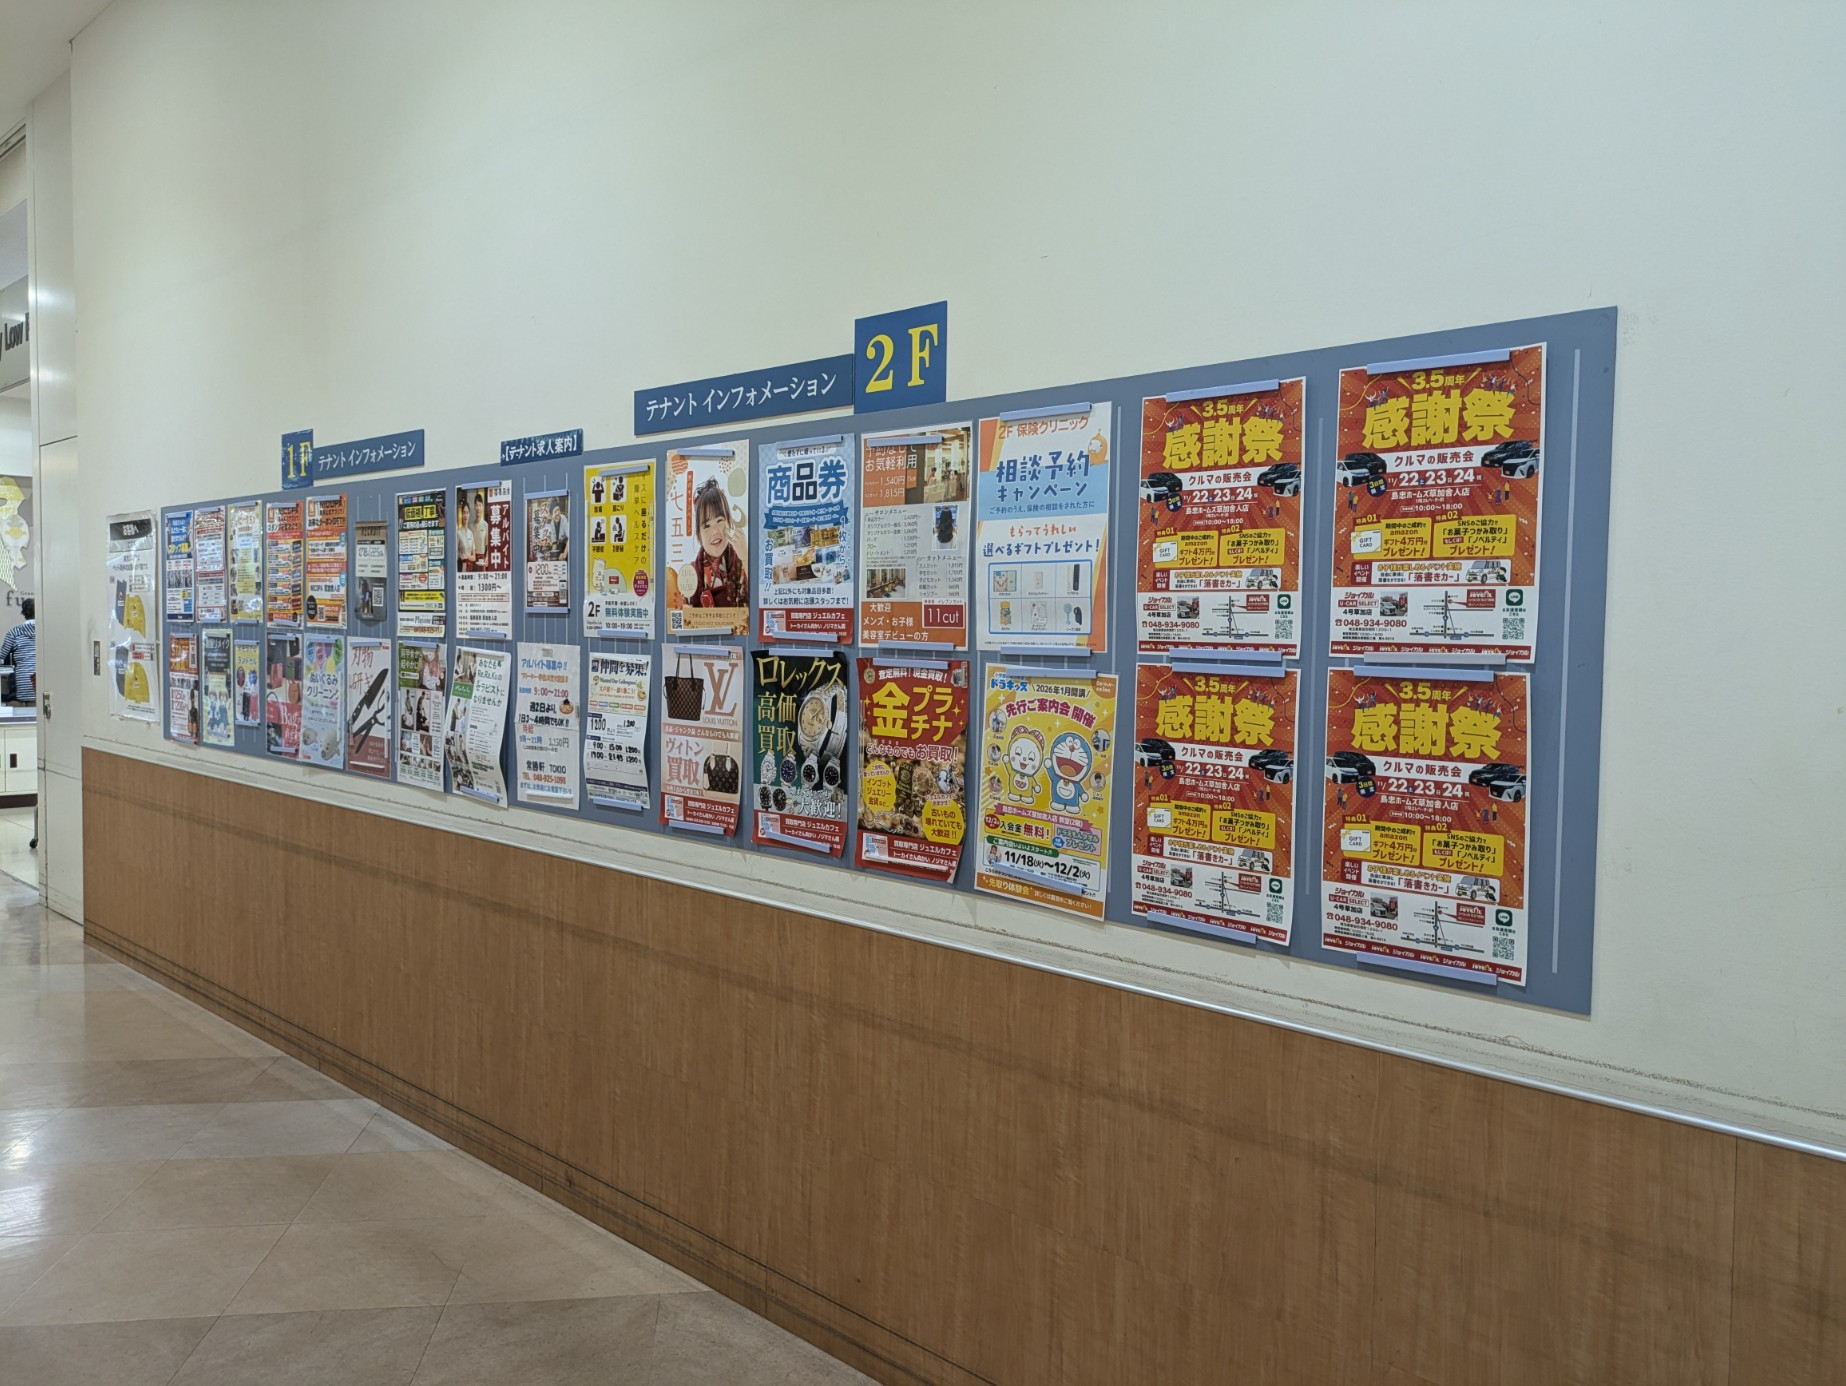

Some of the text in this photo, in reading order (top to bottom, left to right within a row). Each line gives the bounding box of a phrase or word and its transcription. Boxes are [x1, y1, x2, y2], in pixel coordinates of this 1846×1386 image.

[5, 322, 23, 351] Low
[866, 324, 938, 393] 2F
[1412, 369, 1465, 390] 3.5周年
[646, 373, 837, 421] テナントインフォメーション
[1202, 400, 1244, 417] 3.5周年
[1362, 388, 1515, 449] 感謝祭
[999, 416, 1089, 440] 2F 保険クリニック
[1162, 416, 1284, 469] 感謝祭
[288, 442, 313, 478] 1F
[318, 442, 416, 471] テナントインフォメーション
[866, 454, 917, 472] お気軽利用
[1394, 450, 1475, 468] クルマの販売会
[996, 450, 1090, 483] 相談予約
[767, 460, 846, 504] 商品券
[880, 475, 905, 486] 1,540円
[1188, 471, 1252, 486] クルマの販売会
[880, 487, 905, 499] 1,815円
[997, 482, 1088, 502] キャンペーン
[1391, 488, 1470, 500] 島忠ホームズ草加舎人店
[989, 501, 1095, 514] ご予約のうえ、保険の相談をされた方に
[1415, 503, 1463, 511] 10:00〜18:00
[671, 491, 684, 562] 七五三
[1010, 523, 1077, 537] もらってうれしい
[1457, 519, 1499, 527] SNSのご協力で
[490, 504, 501, 569] 募集中
[1443, 527, 1508, 535] 「お菓子つかみ取り」
[1468, 536, 1507, 544] 「ノベルティ」
[983, 539, 1100, 557] 選べるギフトプレゼント!
[1383, 545, 1425, 556] プレゼント!
[1449, 545, 1495, 556] プレゼント!
[1179, 557, 1213, 566] プレゼント!
[1232, 556, 1268, 565] プレゼント!
[1199, 579, 1241, 588] 「落書きカー」
[1408, 572, 1460, 582] 「落書きカー」
[588, 602, 600, 617] 2F
[870, 603, 891, 612] 大歓迎
[863, 617, 913, 627] メンズ・お子様
[928, 608, 959, 623] 11cut
[1344, 619, 1407, 628] 048-934-9080
[862, 630, 928, 641] 美容室デビューの方
[756, 656, 844, 692] ロレックス
[990, 678, 1028, 692] ドラキッズ
[1035, 684, 1086, 698] 2026年1月開講
[1195, 676, 1236, 693] 3.5周年
[1399, 682, 1451, 701] 3.5周年
[758, 691, 797, 723] 高価
[913, 685, 953, 714] プラ
[872, 682, 910, 738] 金
[1006, 698, 1096, 729] 先行ご案内会 開催
[1155, 695, 1275, 746] 感謝祭
[911, 715, 952, 742] チナ
[1351, 702, 1502, 760] 感謝祭
[666, 738, 704, 756] ヴィトン
[758, 724, 797, 756] 買取
[867, 744, 958, 763] どんなものでもお買取!
[1181, 747, 1244, 762] クルマの販売会
[667, 756, 700, 786] 買取
[1383, 760, 1462, 778] クルマの販売会
[867, 780, 891, 788] インゴット
[867, 788, 891, 797] ジュエリー
[798, 798, 841, 819] 大歓迎!
[1380, 795, 1459, 811] 島忠ホームズ草加舎人店
[931, 809, 955, 819] 古いもの
[1404, 812, 1452, 823] 10:00〜18:00
[925, 818, 962, 830] 壊れていても
[1000, 820, 1050, 839] 入会金 無料!
[1374, 824, 1416, 836] 期間中のご成約で
[931, 829, 957, 839] 大歓迎!!
[1057, 827, 1099, 843] ドラえもんタオル
[1172, 826, 1206, 838] プレゼント!
[1225, 833, 1260, 846] プレゼント!
[1379, 833, 1408, 841] amazon
[1447, 833, 1487, 844] SNSのご協力で
[920, 845, 956, 856] ジュエルカフェ
[1066, 839, 1097, 852] プレゼント
[1431, 840, 1497, 854] 「お菓子つかみ取り」
[1372, 849, 1414, 864] プレゼント!
[1439, 857, 1485, 873] プレゼント!
[989, 877, 1029, 896] 先取り体験会
[1142, 884, 1192, 898] 048-934-9080
[1334, 887, 1365, 898] ジョイカル
[1398, 877, 1450, 894] 「落書きカー」
[1335, 914, 1398, 931] 048-934-9080
